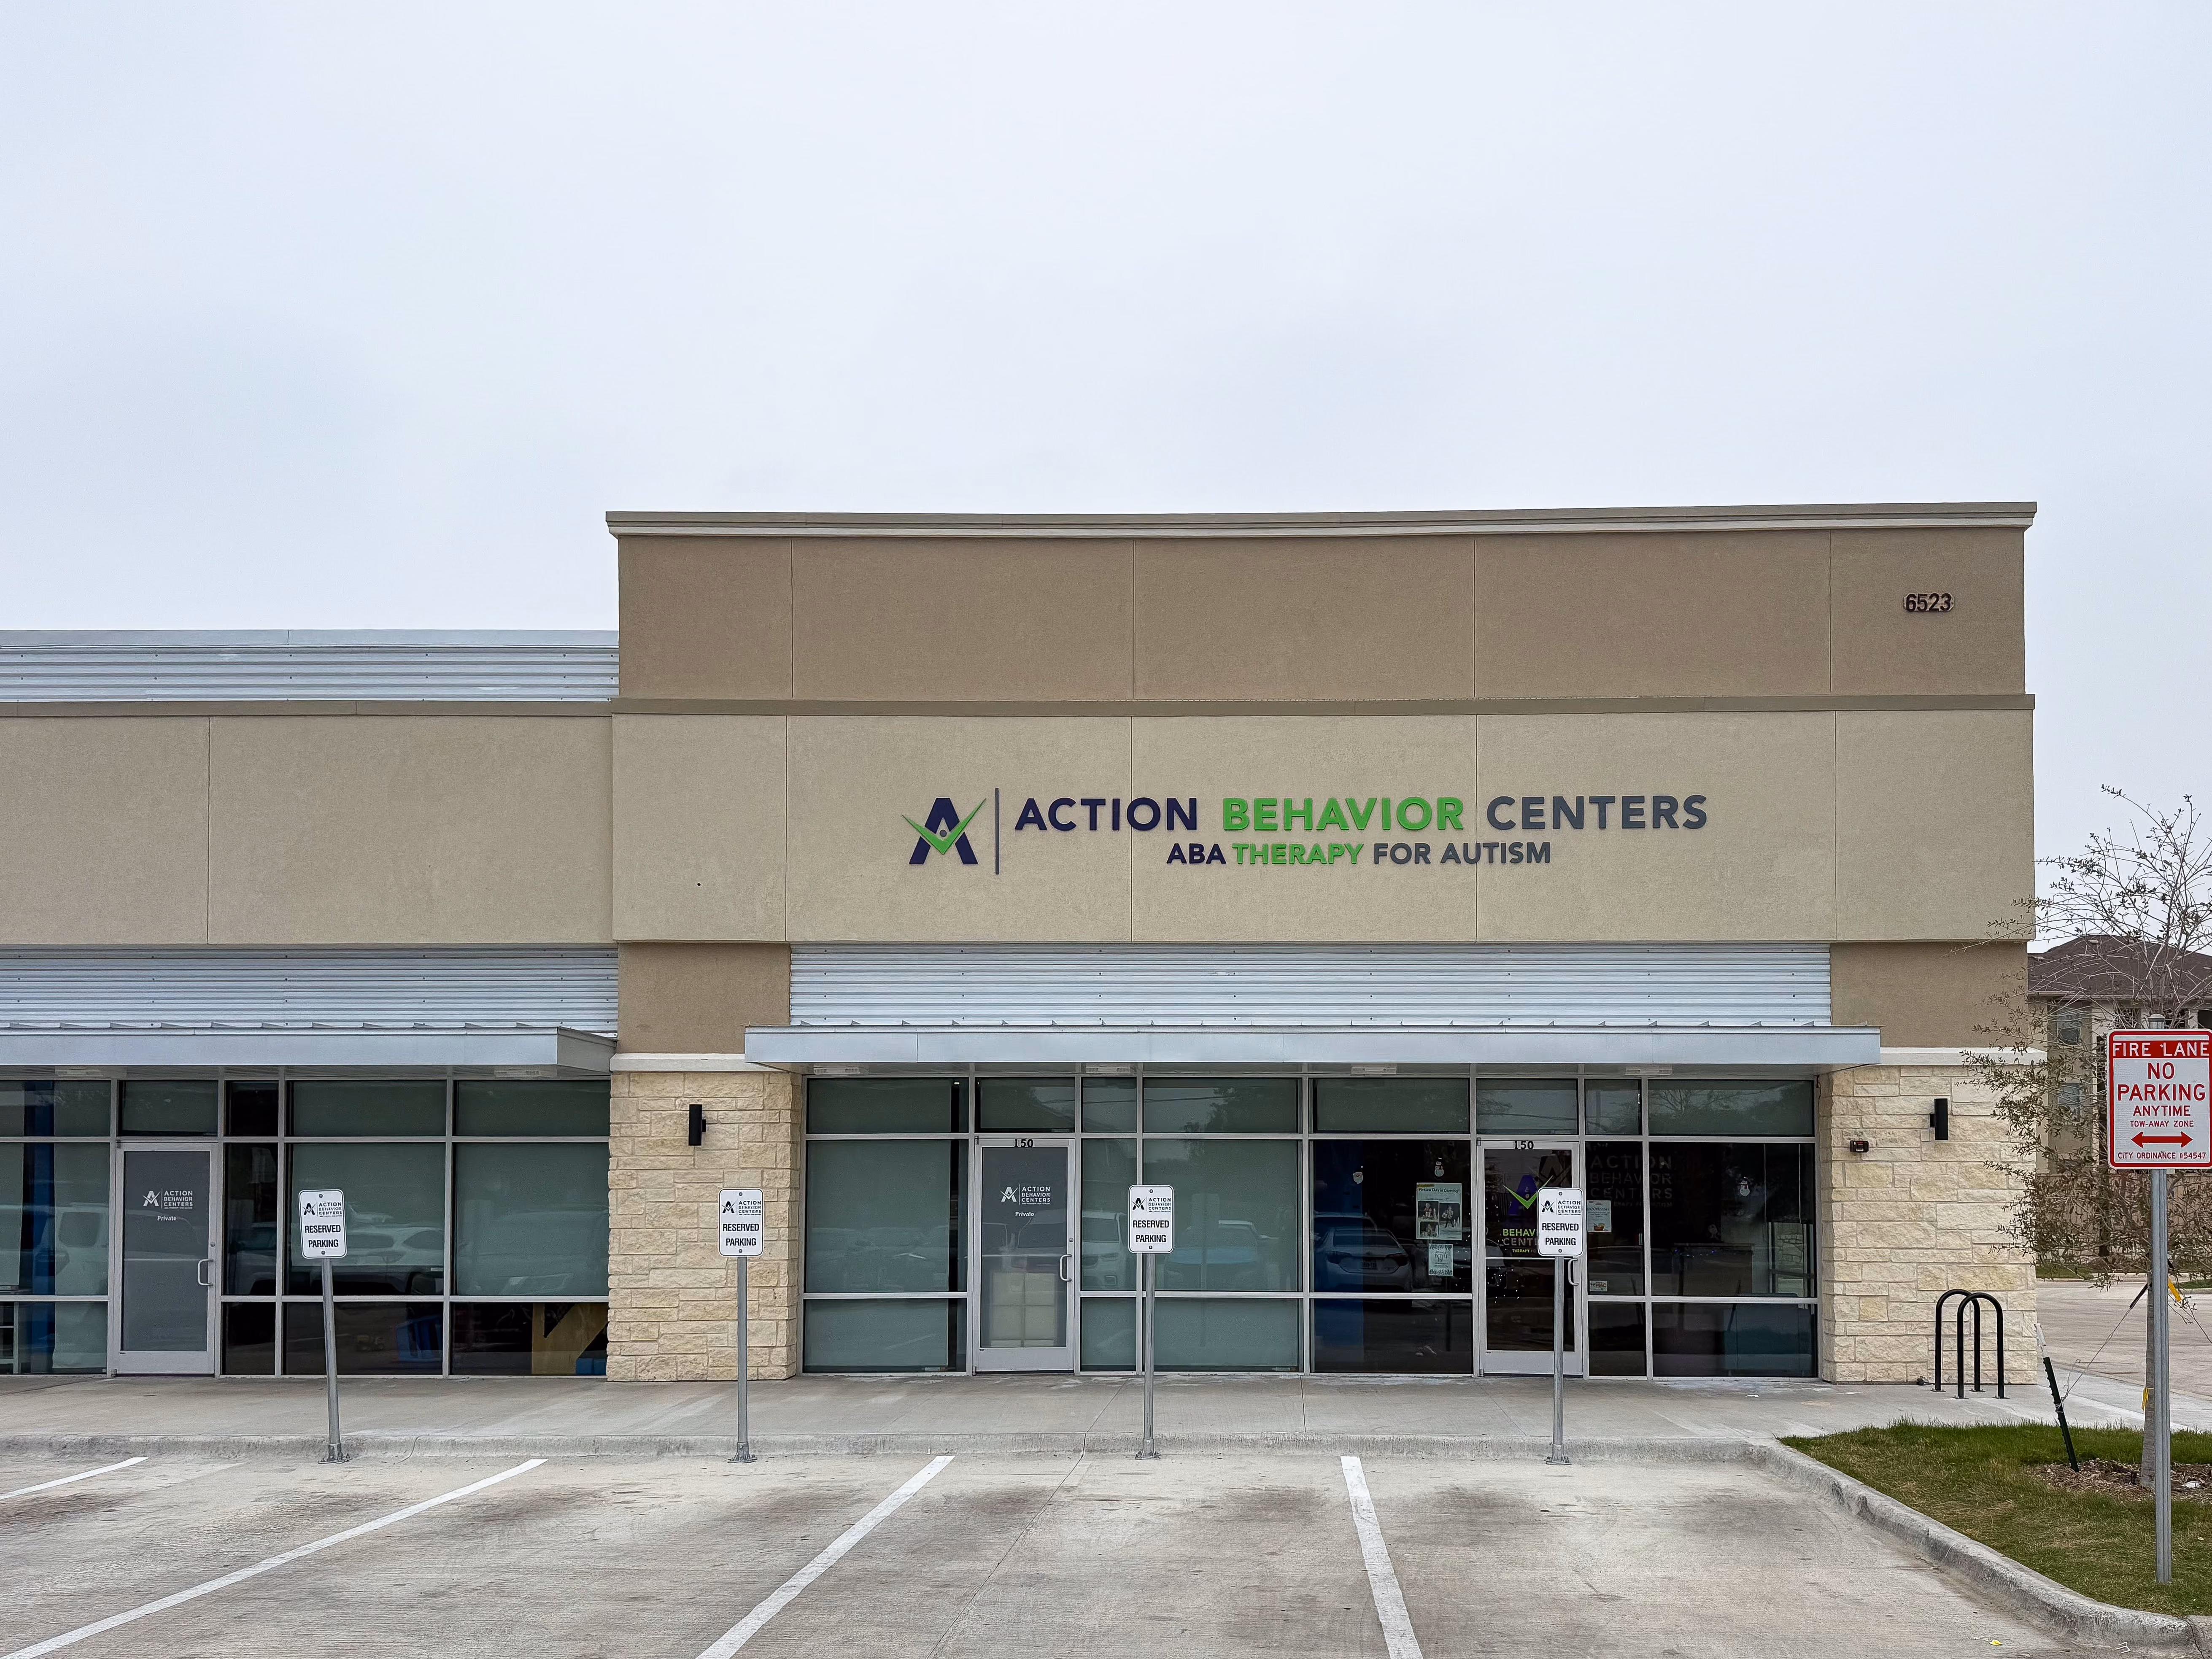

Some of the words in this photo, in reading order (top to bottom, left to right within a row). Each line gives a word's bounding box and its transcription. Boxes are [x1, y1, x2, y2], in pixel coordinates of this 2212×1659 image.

[1904, 593, 1952, 612] 6523
[1014, 797, 1197, 831] ACTION
[1223, 797, 1464, 831] BEHAVIOR
[1487, 794, 1707, 830] CENTERS
[1166, 843, 1227, 864] ABA
[1232, 843, 1364, 864] THERAPY
[1374, 843, 1431, 864] FOR
[1440, 842, 1550, 864] AUTISM
[2113, 1042, 2151, 1056] FIRE
[2163, 1042, 2209, 1056] LANE
[2147, 1062, 2174, 1079] NO
[2117, 1083, 2206, 1101] PARKING
[2133, 1105, 2190, 1116] ANYTIME
[1014, 1138, 1033, 1148] 150
[1514, 1141, 1534, 1149] 150
[1589, 1172, 1672, 1184] BEHAVOR
[1590, 1187, 1672, 1198] CENTRS
[723, 1223, 760, 1231] RESERVED
[1133, 1220, 1169, 1228] RESERVED
[1542, 1223, 1579, 1231] RESERVED
[305, 1225, 341, 1233] RESERVED
[1503, 1228, 1536, 1236] BEHAV
[726, 1238, 756, 1246] PARKING
[1136, 1234, 1166, 1242] PARKING
[1545, 1237, 1576, 1246] PARKING
[308, 1239, 339, 1248] PARKING
